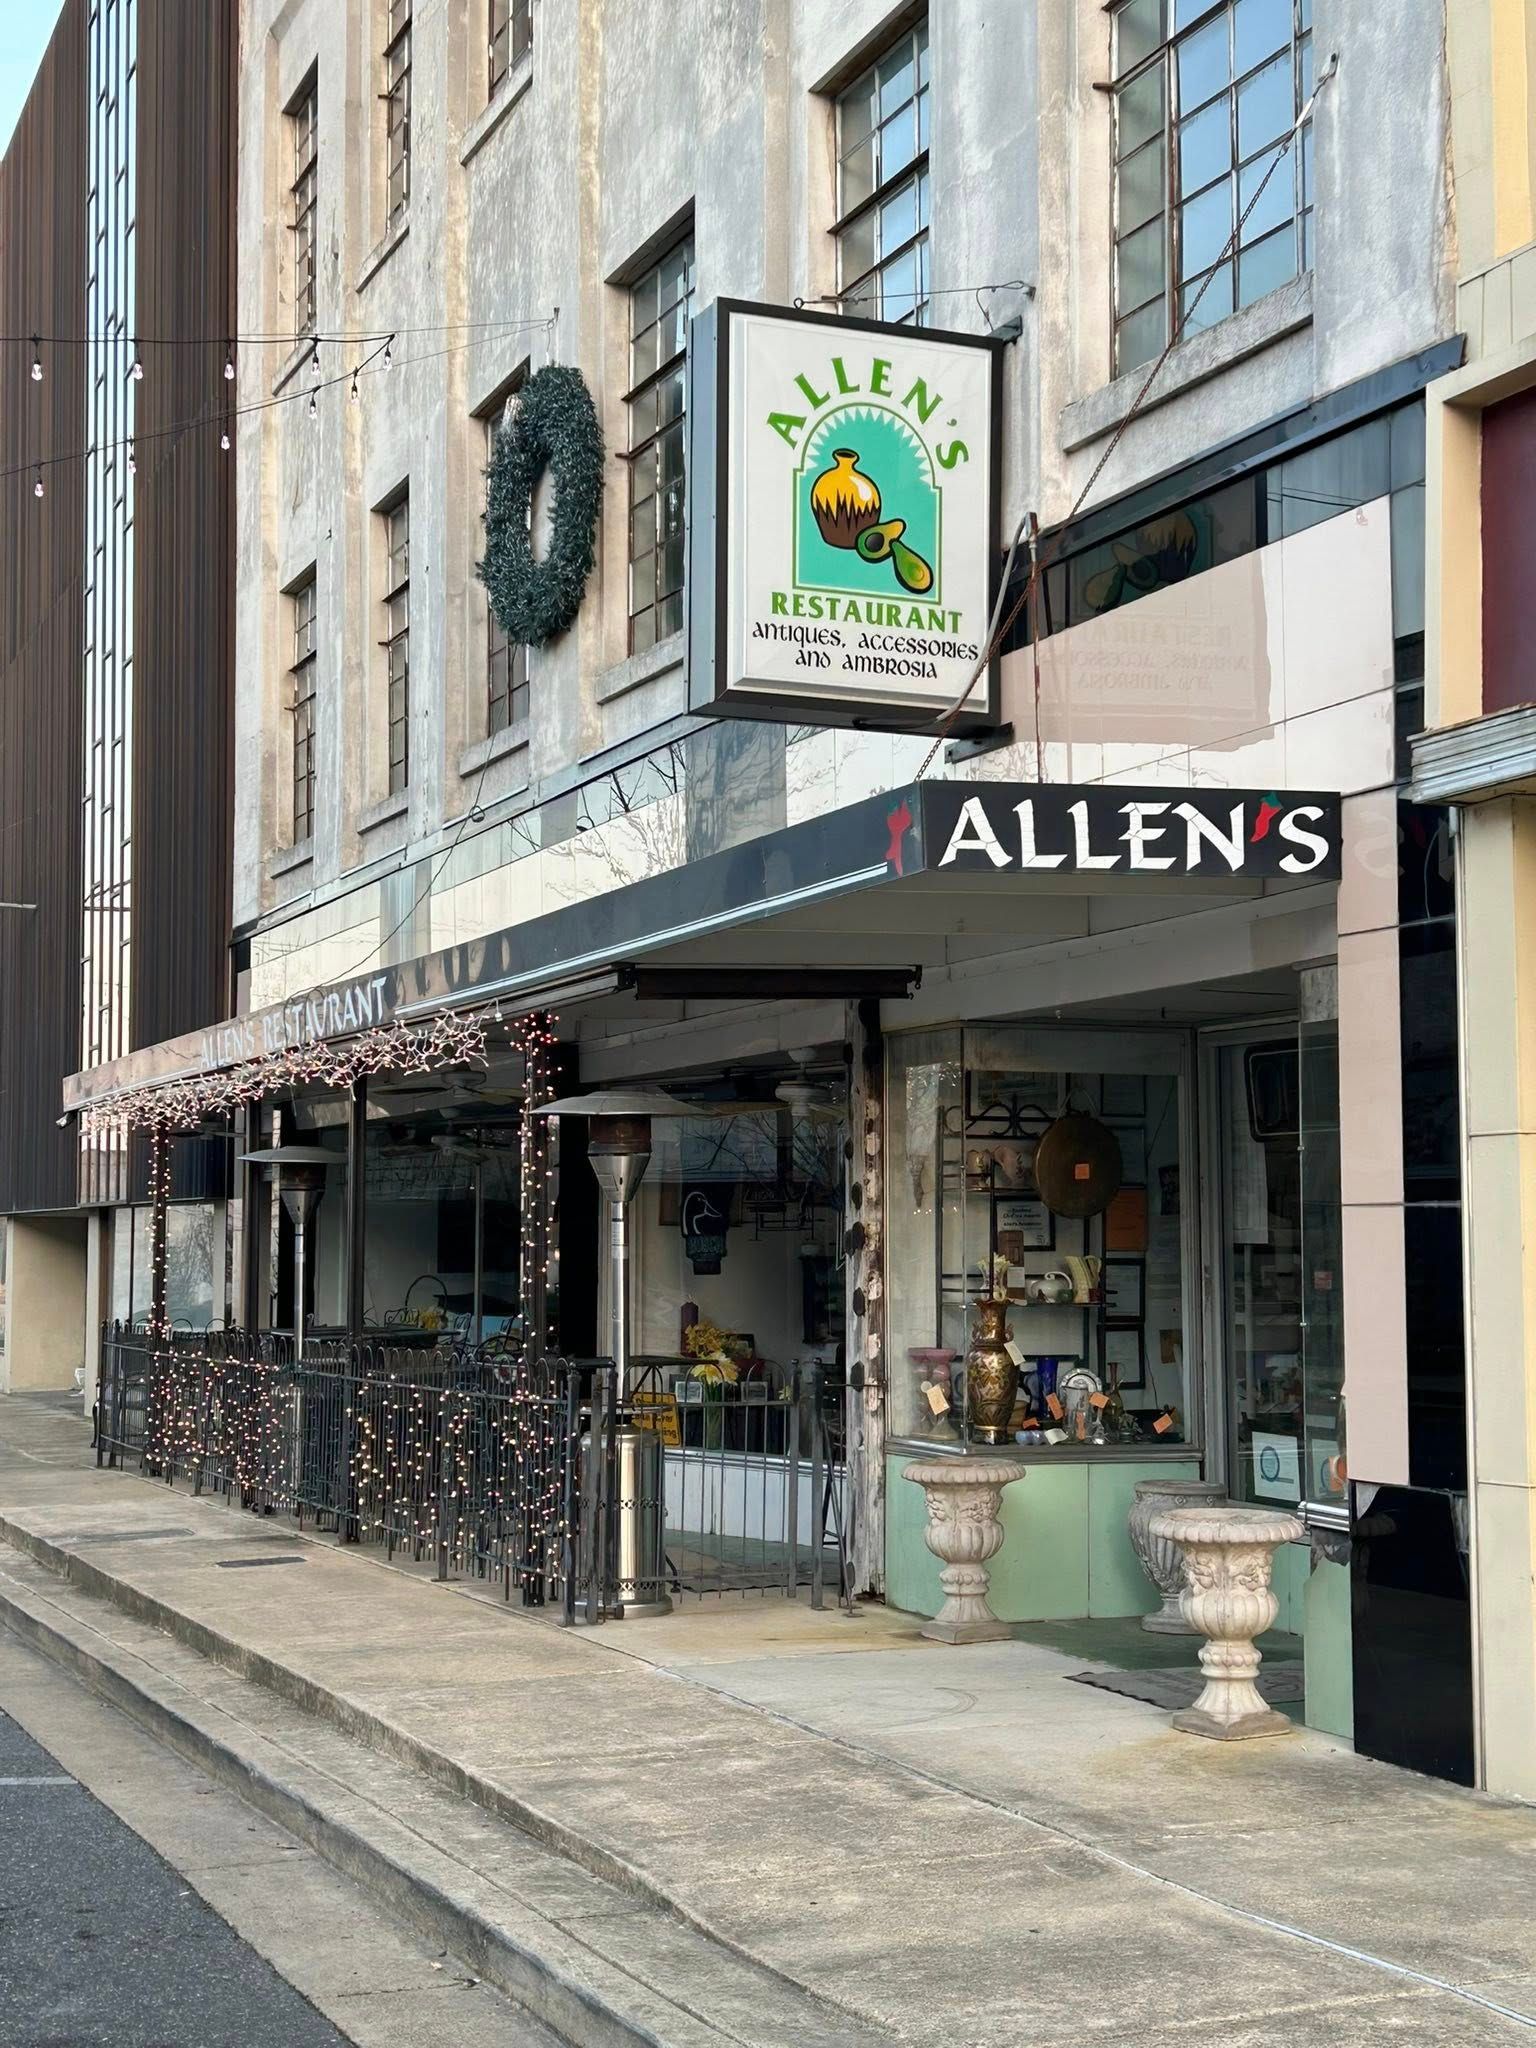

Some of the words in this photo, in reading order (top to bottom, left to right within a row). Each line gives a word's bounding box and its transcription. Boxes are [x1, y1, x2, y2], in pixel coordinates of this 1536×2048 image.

[766, 356, 969, 471] ALLEN'S
[771, 591, 963, 634] RESTAURANT
[841, 653, 938, 679] AMBROSIA
[858, 632, 979, 662] ACCESSORIES
[938, 792, 1330, 874] ALLEN'S
[262, 976, 387, 1051] RESTAURANT
